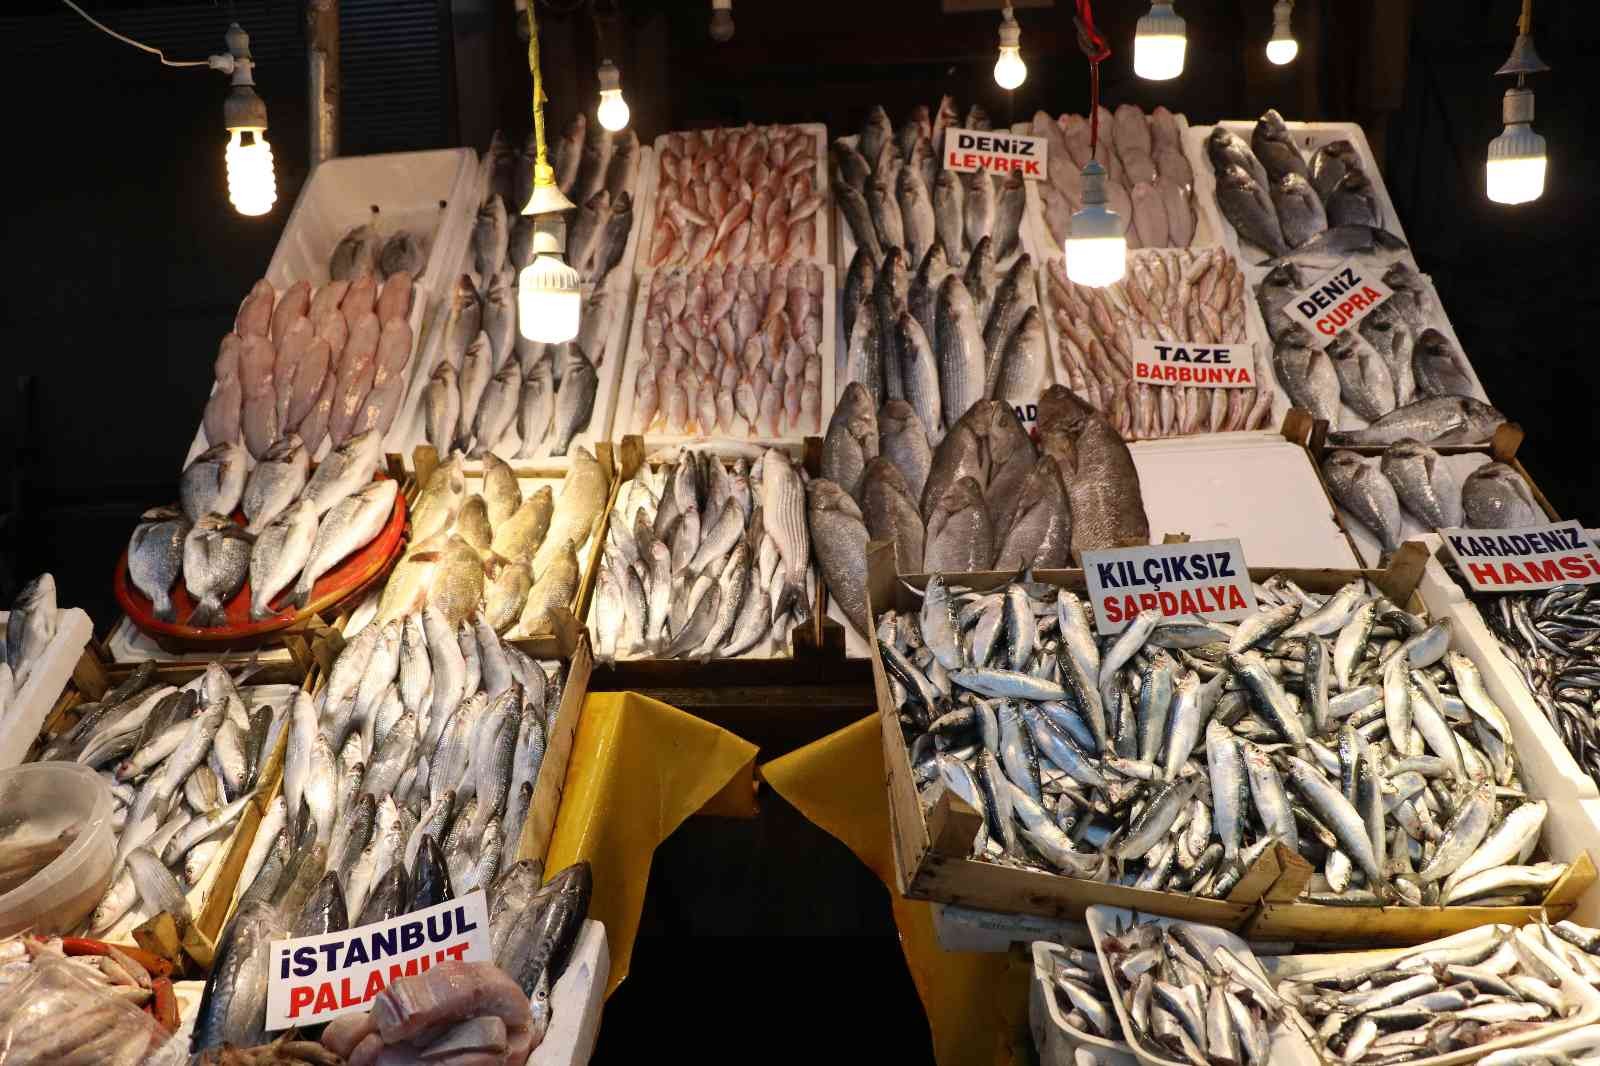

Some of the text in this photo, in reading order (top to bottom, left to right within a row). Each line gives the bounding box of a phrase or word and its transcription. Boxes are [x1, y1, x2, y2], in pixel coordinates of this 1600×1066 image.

[950, 152, 1040, 176] LEVREK
[1154, 345, 1231, 364] TAZE
[1136, 363, 1251, 383] BARBUNYA
[1097, 552, 1235, 591] KILÇIKSIZ
[1103, 585, 1247, 623] SARDALYA
